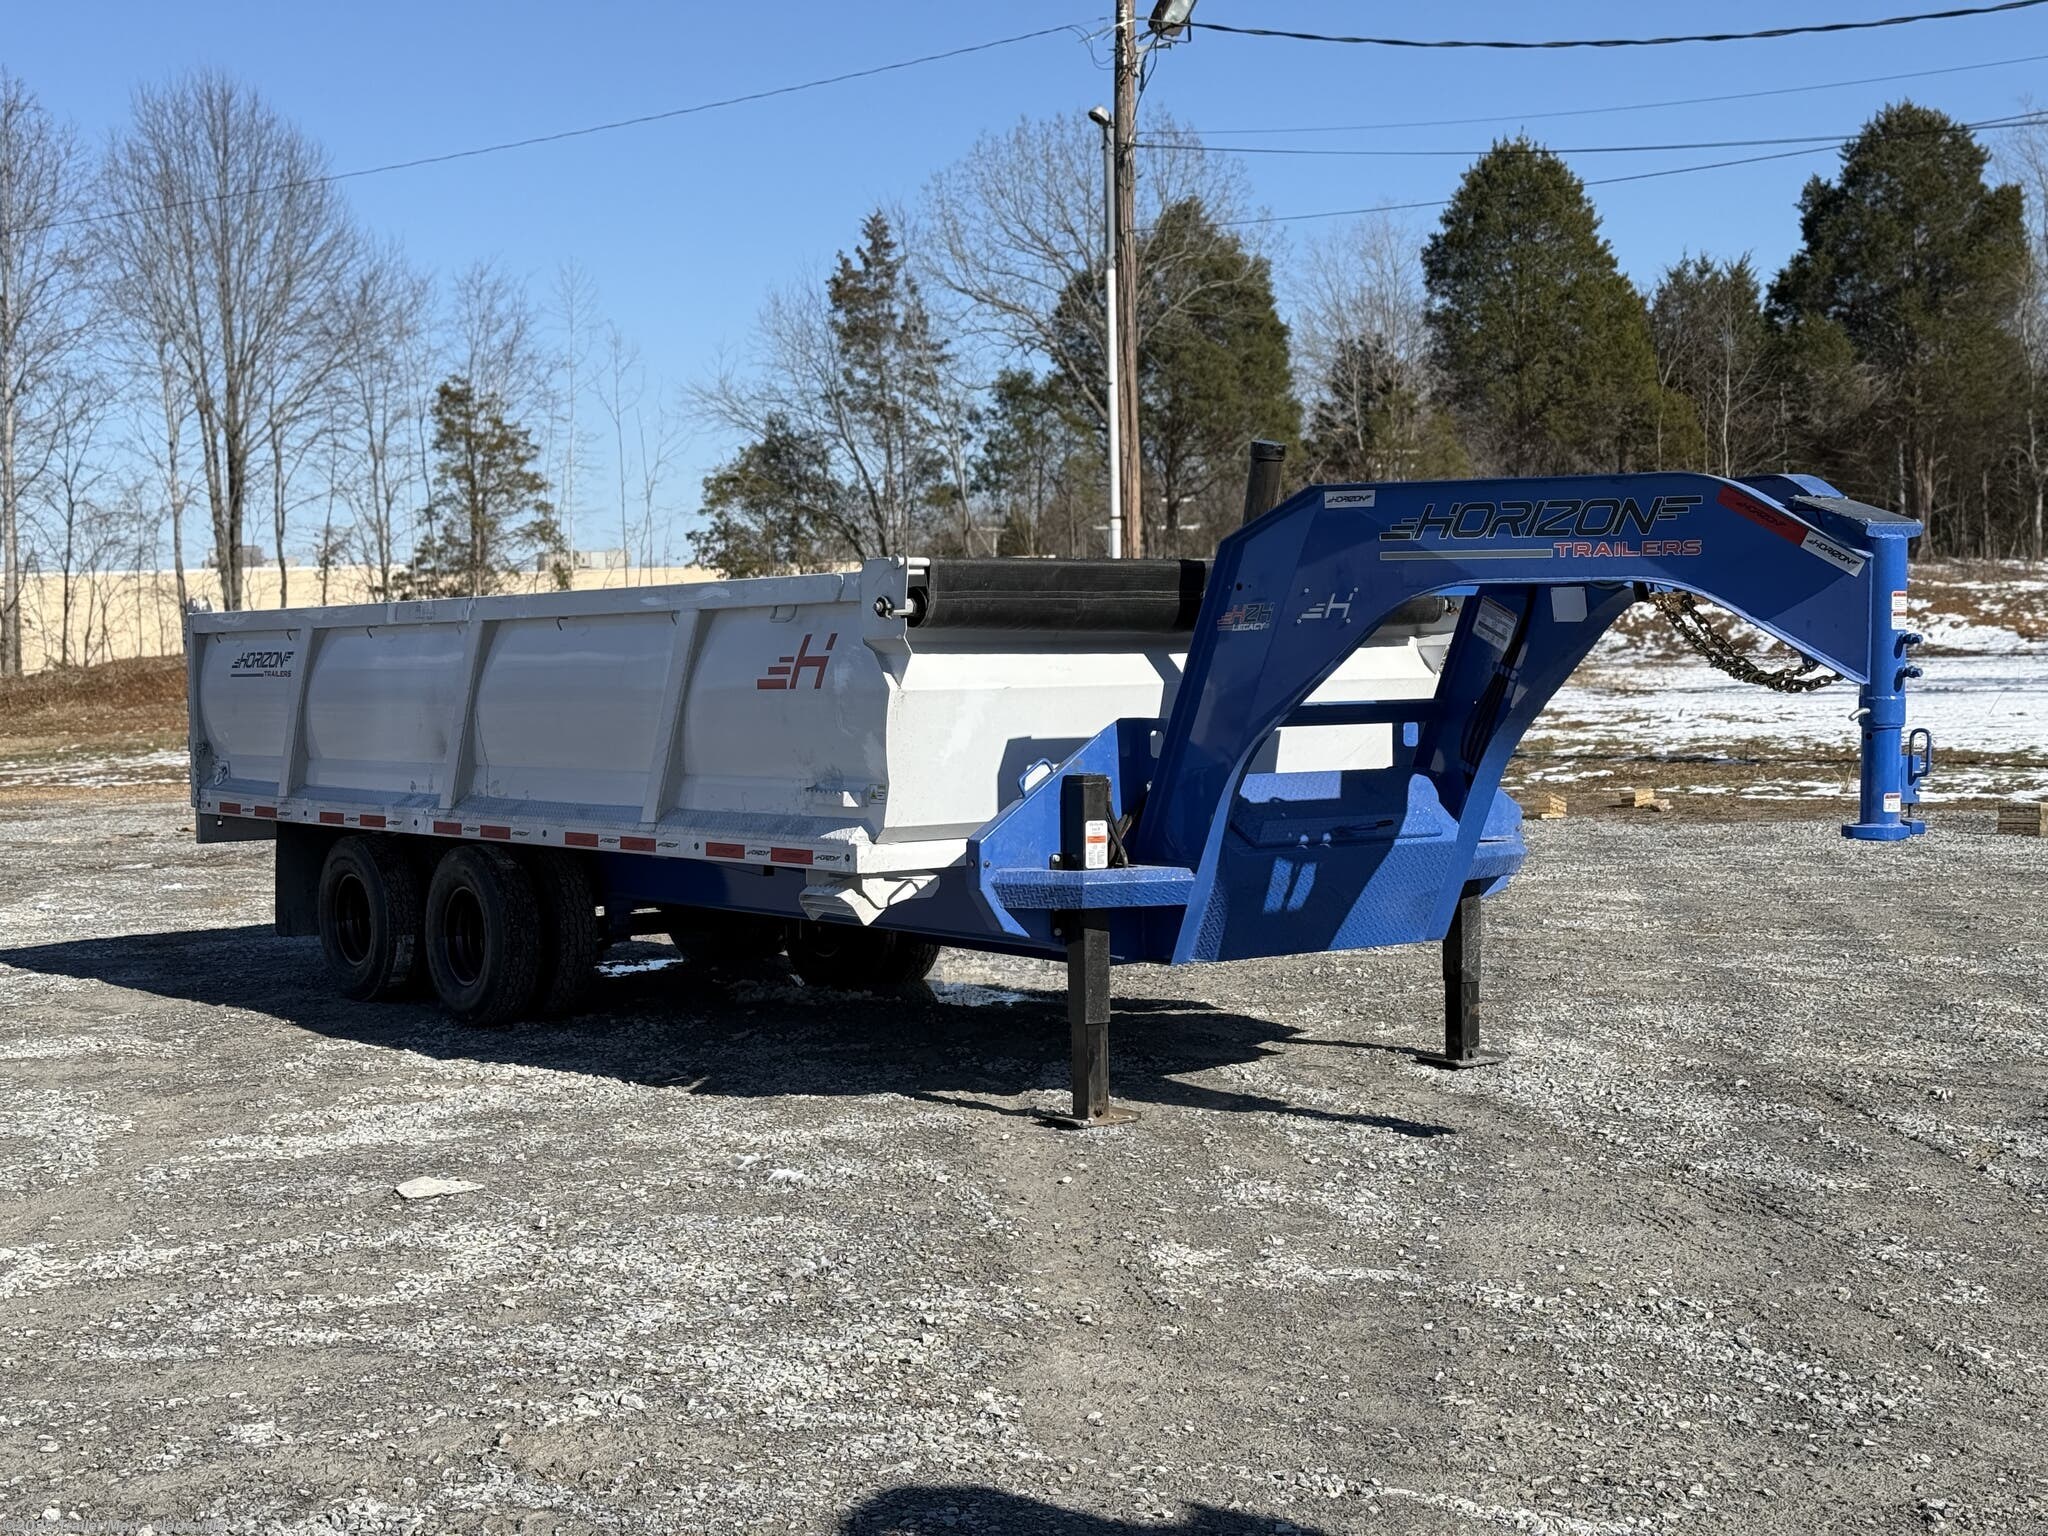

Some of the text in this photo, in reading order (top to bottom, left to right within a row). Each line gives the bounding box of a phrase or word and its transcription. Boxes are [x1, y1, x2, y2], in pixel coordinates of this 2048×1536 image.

[1410, 496, 1668, 541] HORIZON
[1553, 540, 1703, 558] TRAILERS
[1812, 539, 1854, 566] HORIZON
[1232, 622, 1264, 632] LEGACY
[237, 651, 290, 669] HORIZON
[263, 670, 292, 678] TRAILERS
